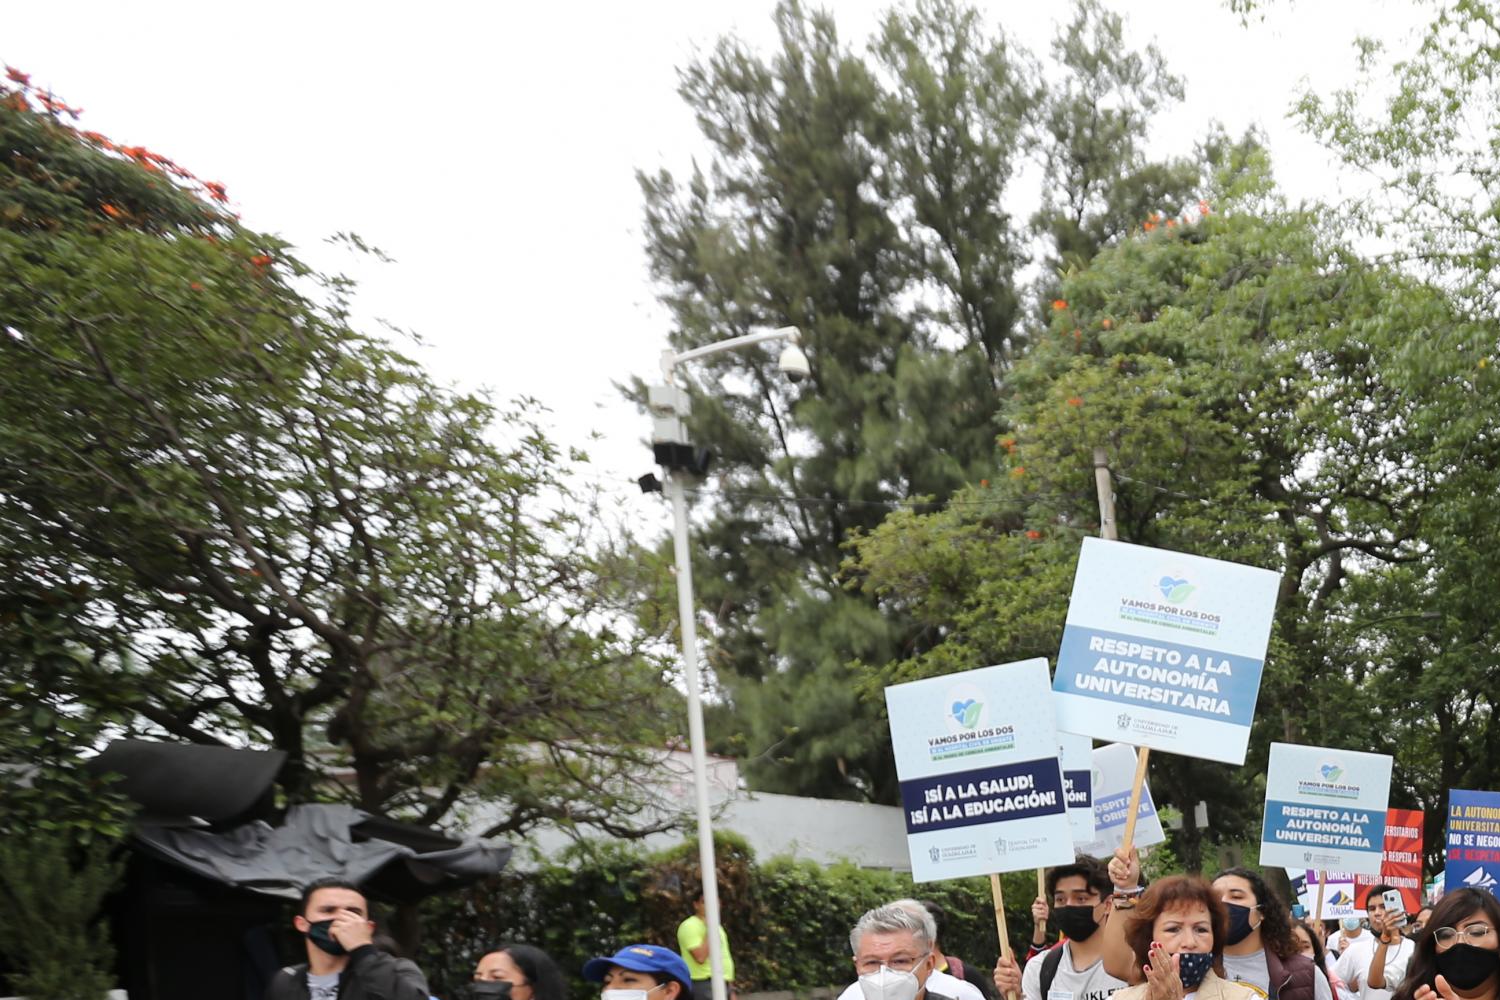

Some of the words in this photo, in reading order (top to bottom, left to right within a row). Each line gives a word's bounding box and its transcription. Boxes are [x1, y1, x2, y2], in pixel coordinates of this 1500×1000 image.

[1121, 599, 1156, 611] VAMOS
[1158, 605, 1178, 615] POR
[1180, 609, 1198, 618] LOS
[1200, 613, 1221, 623] DOS
[1089, 636, 1182, 666] RESPETO
[1184, 655, 1201, 670] A
[1205, 657, 1232, 676] LA
[1094, 657, 1219, 693] AUTONOMÍA
[1075, 673, 1231, 716] UNIVERSITARIA
[928, 734, 958, 746] VAMOS
[960, 732, 976, 741] POR
[977, 728, 994, 738] LOS
[995, 725, 1014, 735] DOS
[925, 785, 943, 804] ¡SÍ
[945, 787, 956, 801] A
[957, 782, 978, 799] LA
[979, 774, 1034, 796] SALUD!
[911, 806, 929, 825] ¡SÍ
[930, 808, 942, 822] A
[943, 804, 963, 820] LA
[964, 790, 1056, 817] EDUCACIÓN!
[1282, 806, 1339, 820] RESPETO
[1341, 812, 1351, 822] A
[1353, 813, 1370, 824] LA
[1451, 805, 1461, 817] LA
[1286, 819, 1363, 835] AUTONOMÍA
[1275, 829, 1371, 848] UNIVERSITARIA
[1449, 833, 1461, 845] NO
[1464, 834, 1474, 846] SE
[1413, 853, 1418, 864] A
[1327, 869, 1354, 880] ORIENT
